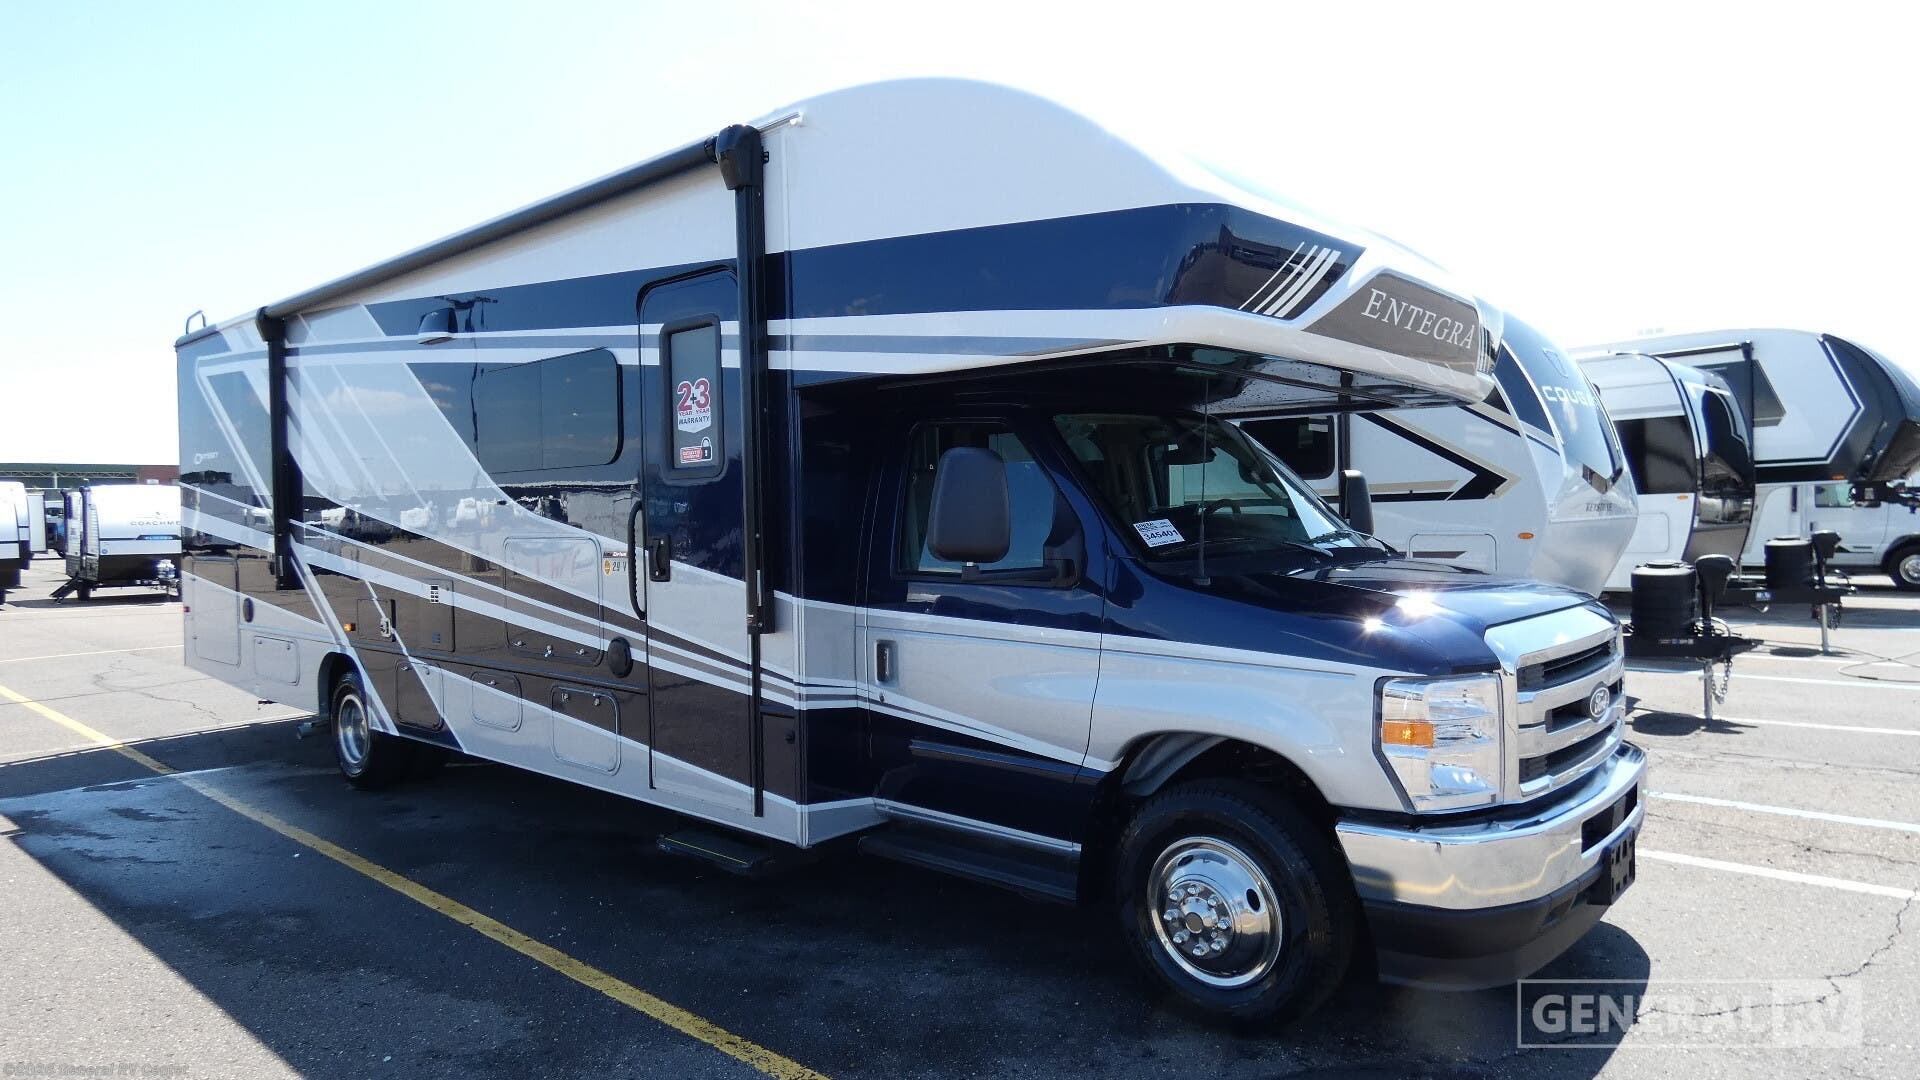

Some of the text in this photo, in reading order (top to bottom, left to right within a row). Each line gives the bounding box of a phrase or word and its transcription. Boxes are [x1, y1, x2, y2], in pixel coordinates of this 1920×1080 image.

[1361, 288, 1475, 349] ENTEGRA
[678, 415, 710, 425] WARRANTY
[1143, 529, 1179, 541] 345401
